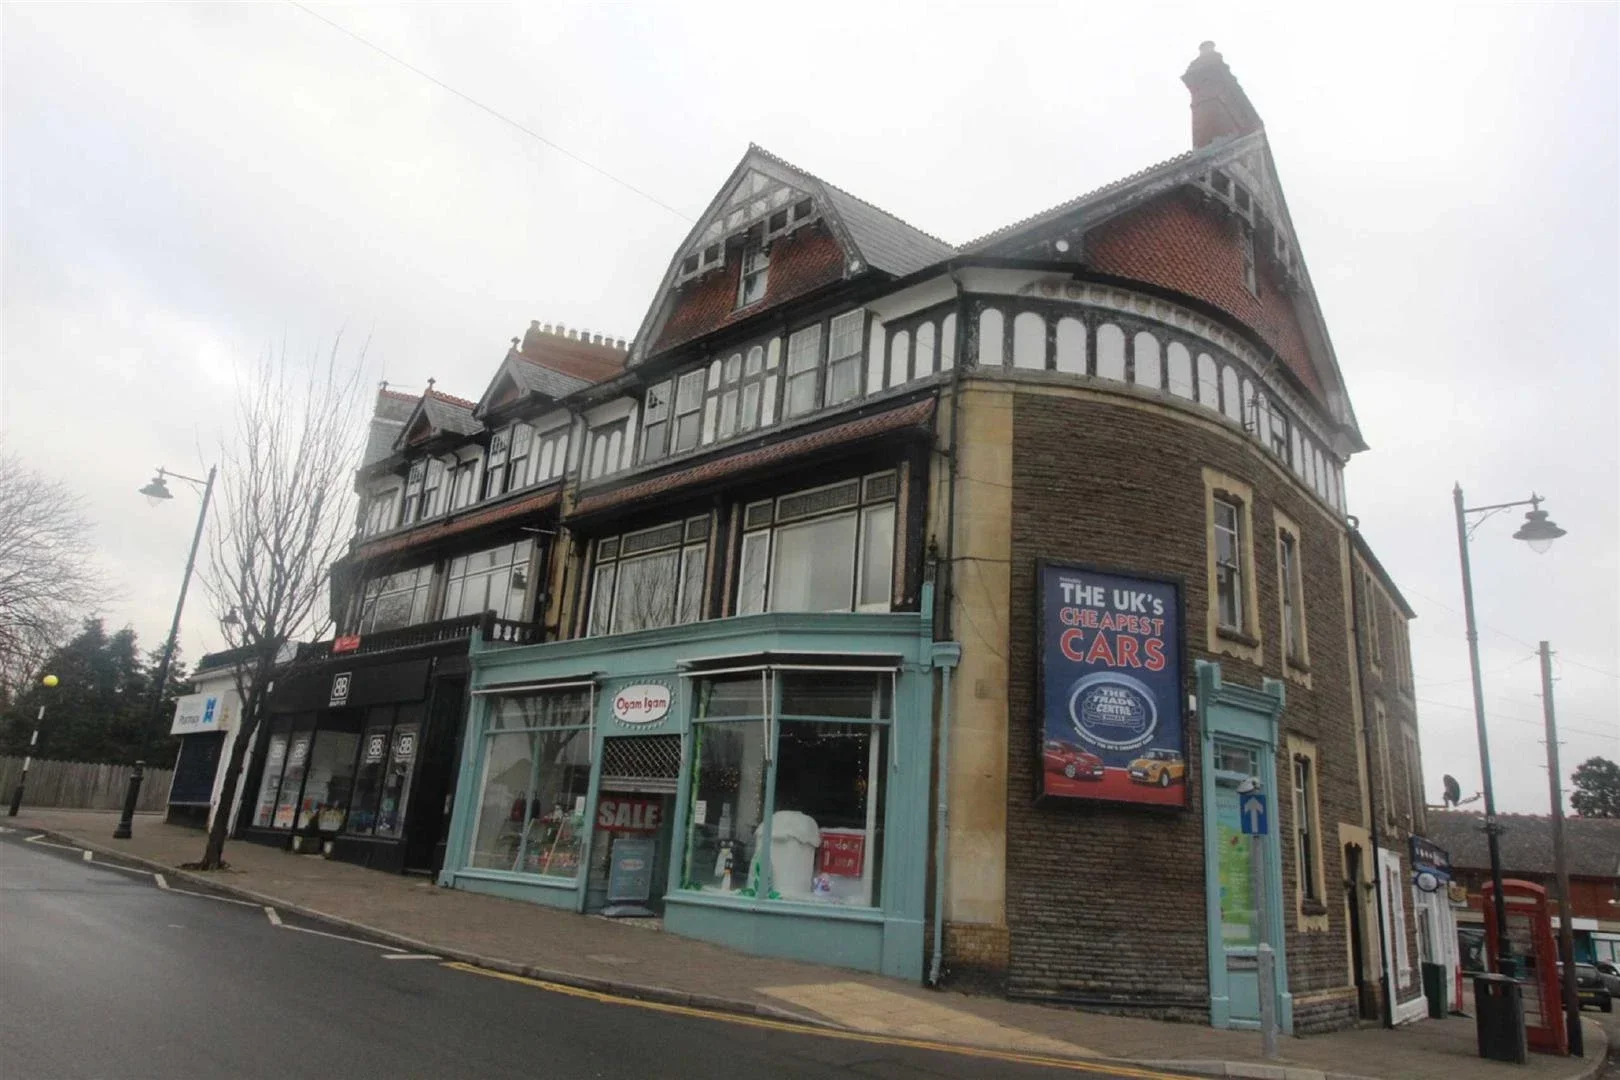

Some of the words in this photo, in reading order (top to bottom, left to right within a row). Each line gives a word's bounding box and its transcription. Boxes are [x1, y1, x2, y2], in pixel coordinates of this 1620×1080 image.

[1060, 582, 1105, 607] THE
[1113, 589, 1164, 615] UK's
[1060, 607, 1164, 636] CHEAPEST
[1060, 628, 1165, 671] CARS
[599, 800, 660, 830] SALE
